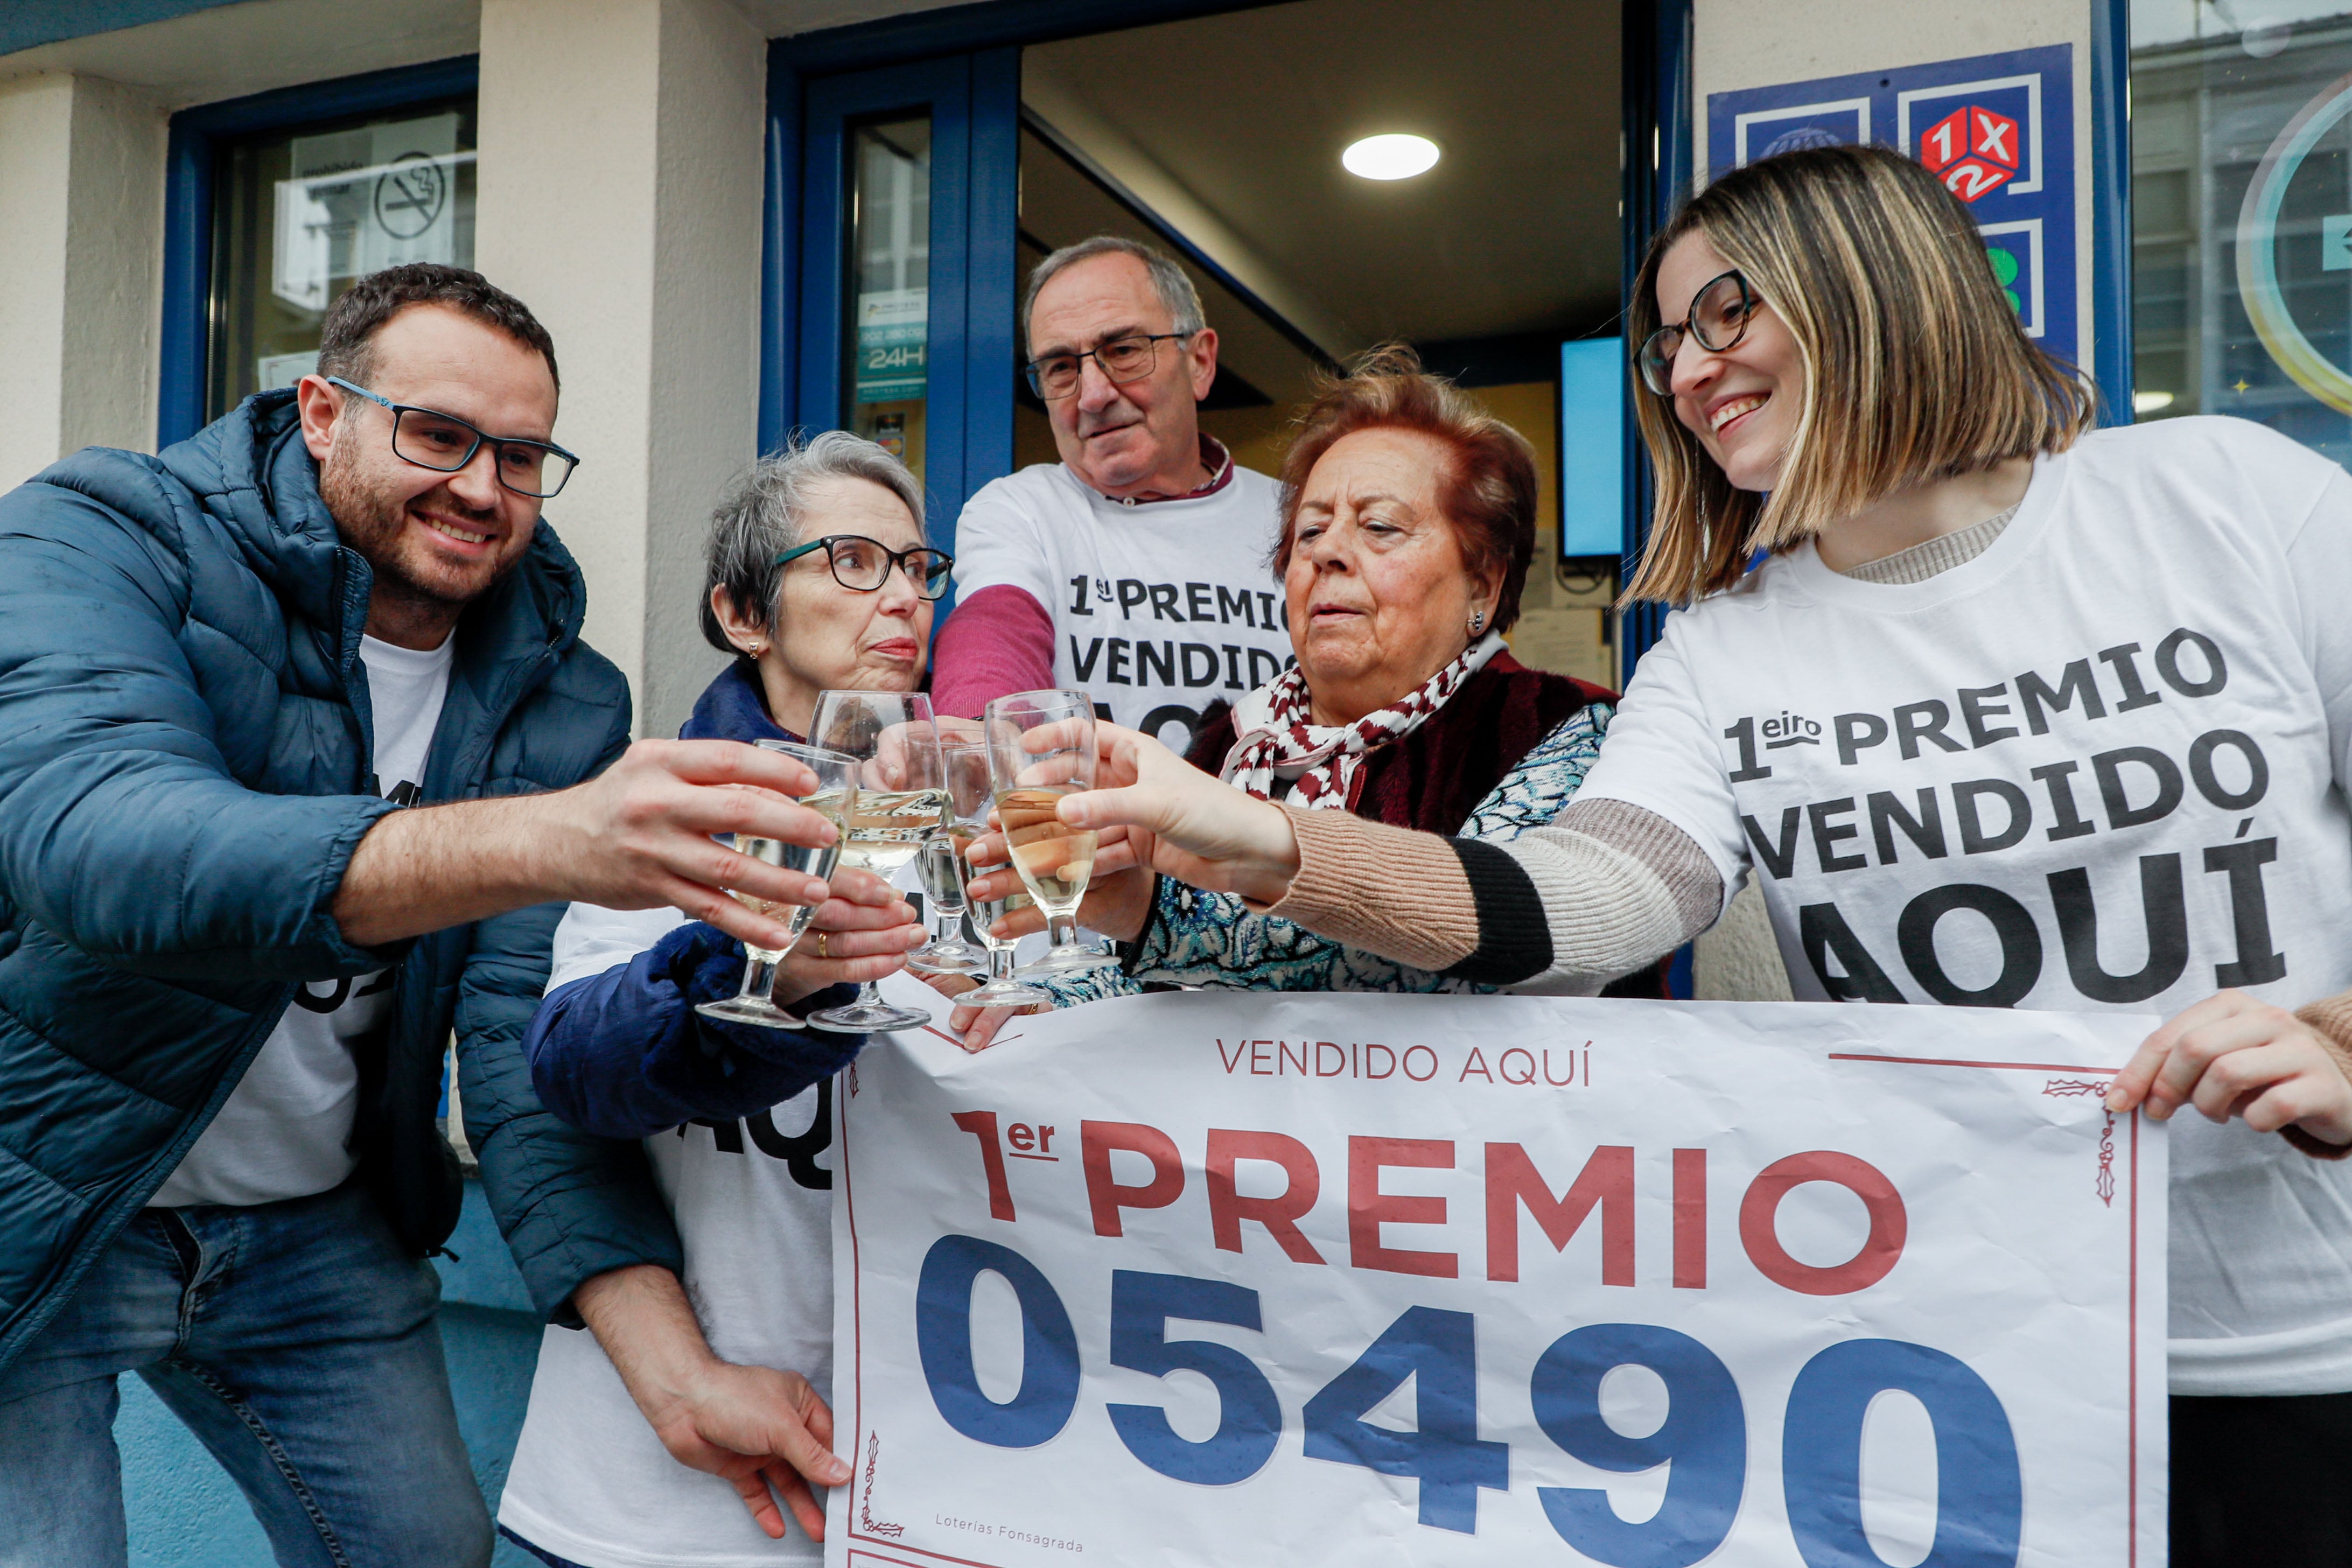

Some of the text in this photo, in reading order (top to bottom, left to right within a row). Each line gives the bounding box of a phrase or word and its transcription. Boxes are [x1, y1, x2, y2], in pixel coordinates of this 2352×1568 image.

[869, 345, 924, 369] 24H
[1116, 578, 1289, 632] PREMI
[1070, 634, 1296, 691] VENDID
[1725, 627, 2228, 783] 1eiro PREMIO
[1742, 729, 2270, 880] VENDIDO
[1216, 1039, 1593, 1087] VENDIDO AQUÍ
[950, 1111, 1059, 1222] 1er
[1080, 1120, 1908, 1296] PREMIO
[915, 1234, 2025, 1568] 05490
[935, 1514, 1083, 1553] Loterías Fonsagrada
